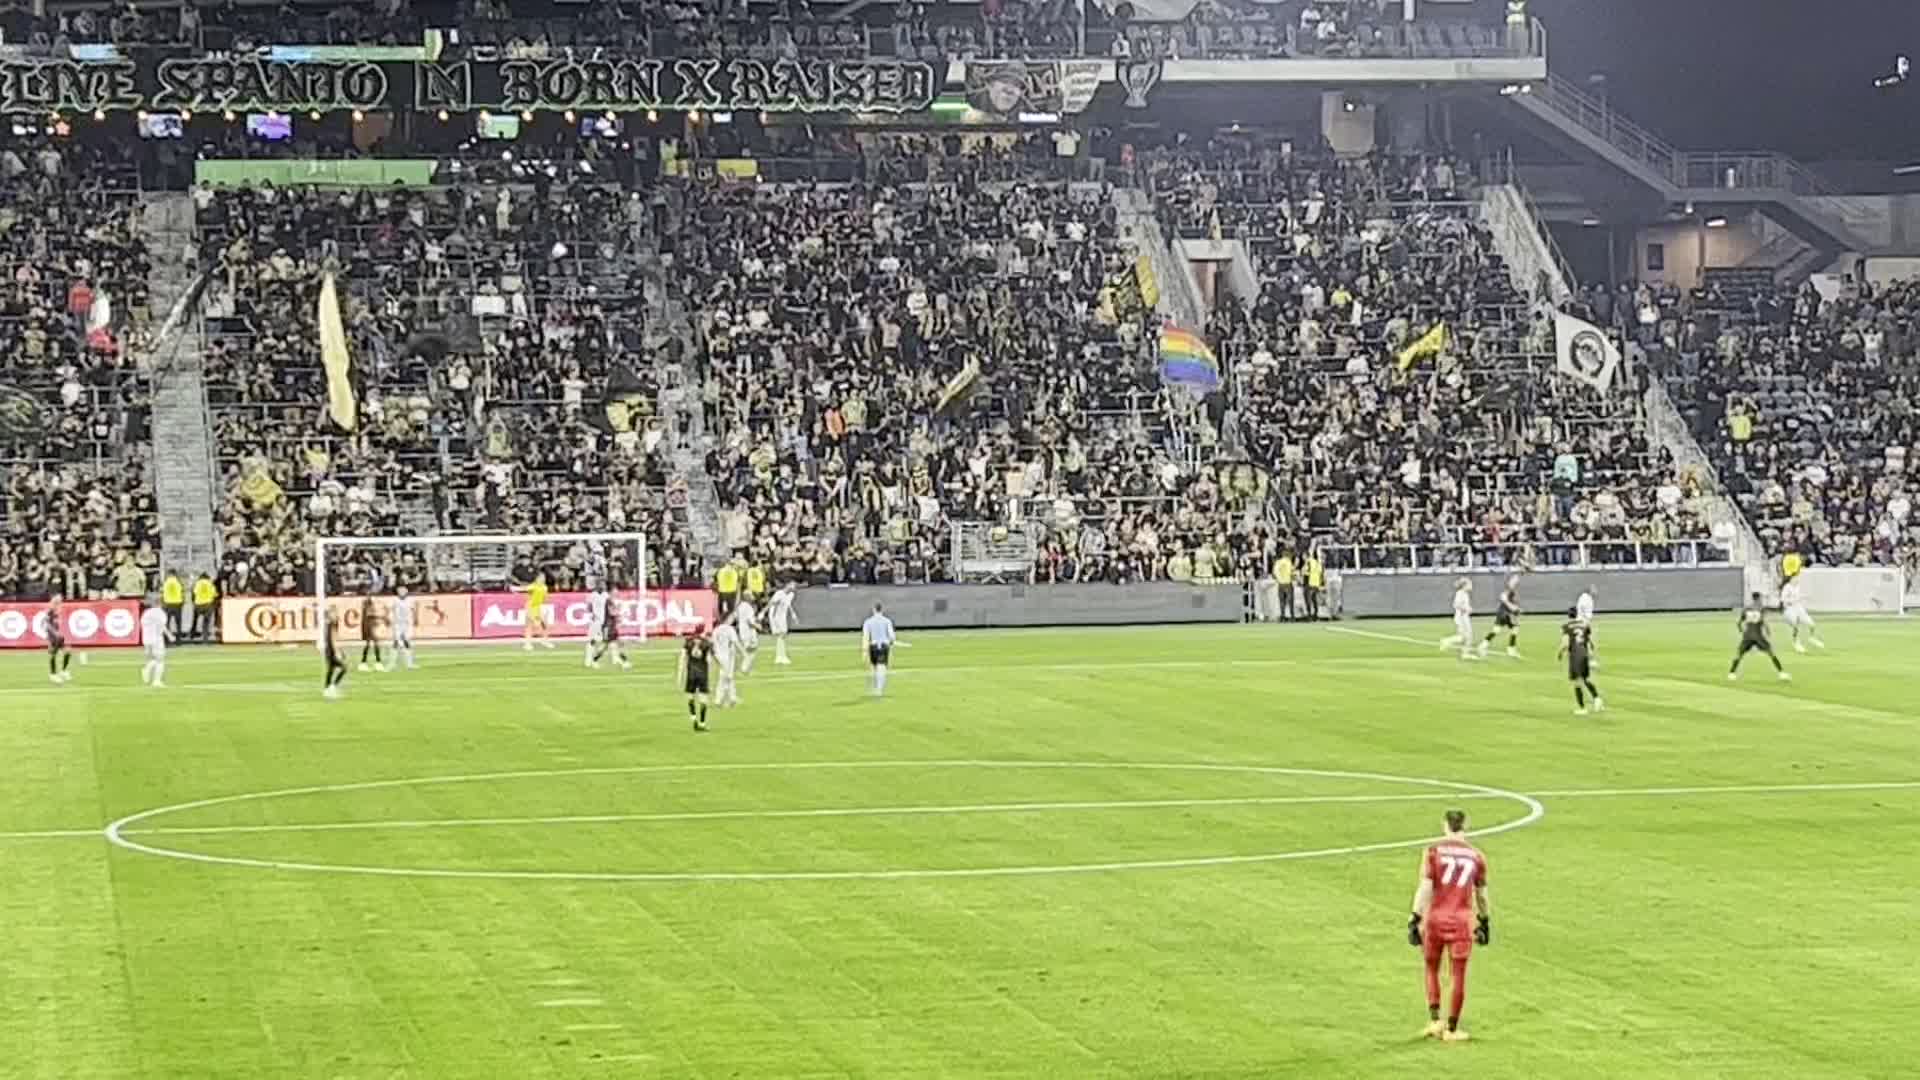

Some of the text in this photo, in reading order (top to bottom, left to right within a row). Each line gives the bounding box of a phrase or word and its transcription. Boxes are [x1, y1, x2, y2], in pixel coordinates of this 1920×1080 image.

[500, 59, 663, 112] BORN
[674, 59, 722, 110] X
[728, 60, 934, 112] RAISED
[1440, 855, 1474, 888] 77
